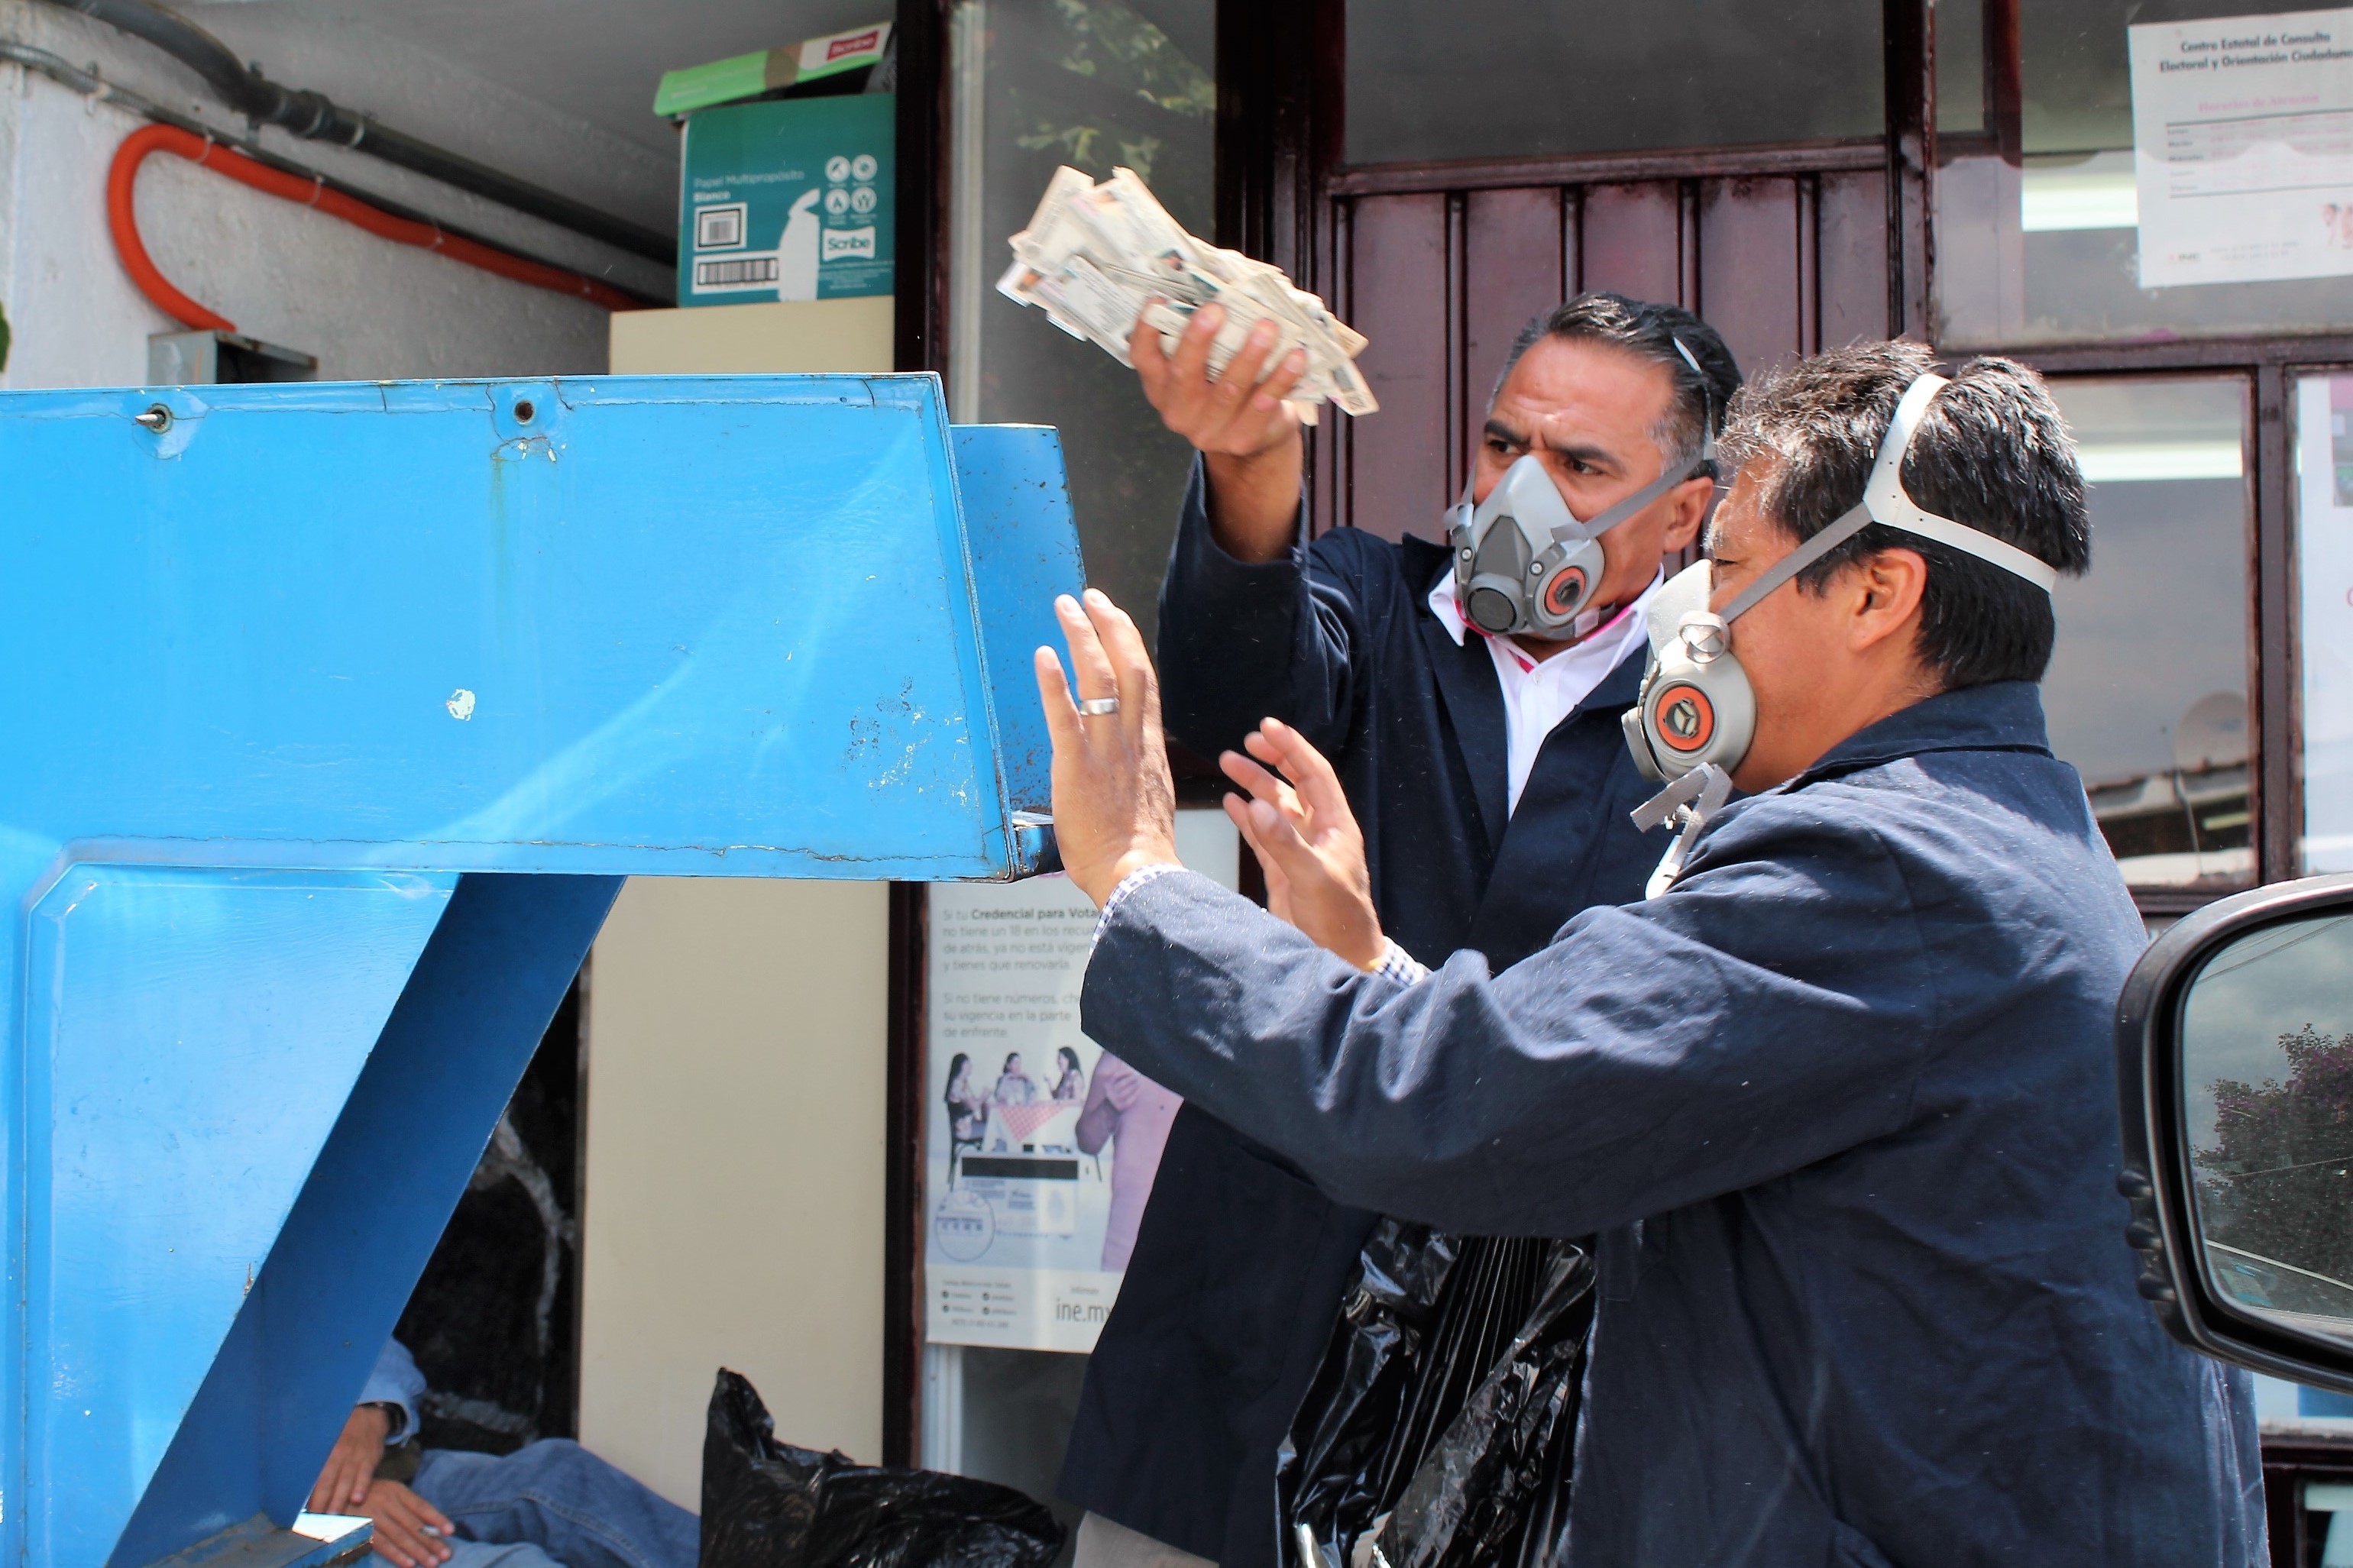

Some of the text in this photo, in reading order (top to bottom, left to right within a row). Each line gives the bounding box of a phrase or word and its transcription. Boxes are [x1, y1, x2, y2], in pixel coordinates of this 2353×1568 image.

[2181, 31, 2331, 53] Centro Estatal de Consulta
[2160, 57, 2209, 73] Electoral
[2212, 58, 2219, 71] y
[2222, 50, 2289, 67] Orientación
[694, 176, 725, 189] Papel
[693, 190, 730, 202] Blanco
[827, 235, 871, 252] Scribe
[943, 907, 1099, 921] Si tu Credencial para Vota
[942, 928, 957, 936] no
[960, 926, 988, 936] tiene
[992, 928, 1008, 936] un
[1009, 925, 1022, 936] 18
[1024, 928, 1039, 936] en
[1042, 924, 1058, 936] los
[942, 942, 958, 954] de
[994, 946, 1008, 955] ya
[1010, 945, 1025, 953] no
[1028, 943, 1054, 953] está
[952, 959, 985, 970] tienes
[989, 961, 1011, 972] que
[943, 993, 953, 1004] Si
[956, 995, 970, 1004] no
[973, 993, 1002, 1004] tiene
[943, 1010, 1072, 1023] su vigencia en la parte
[942, 1026, 958, 1038] de
